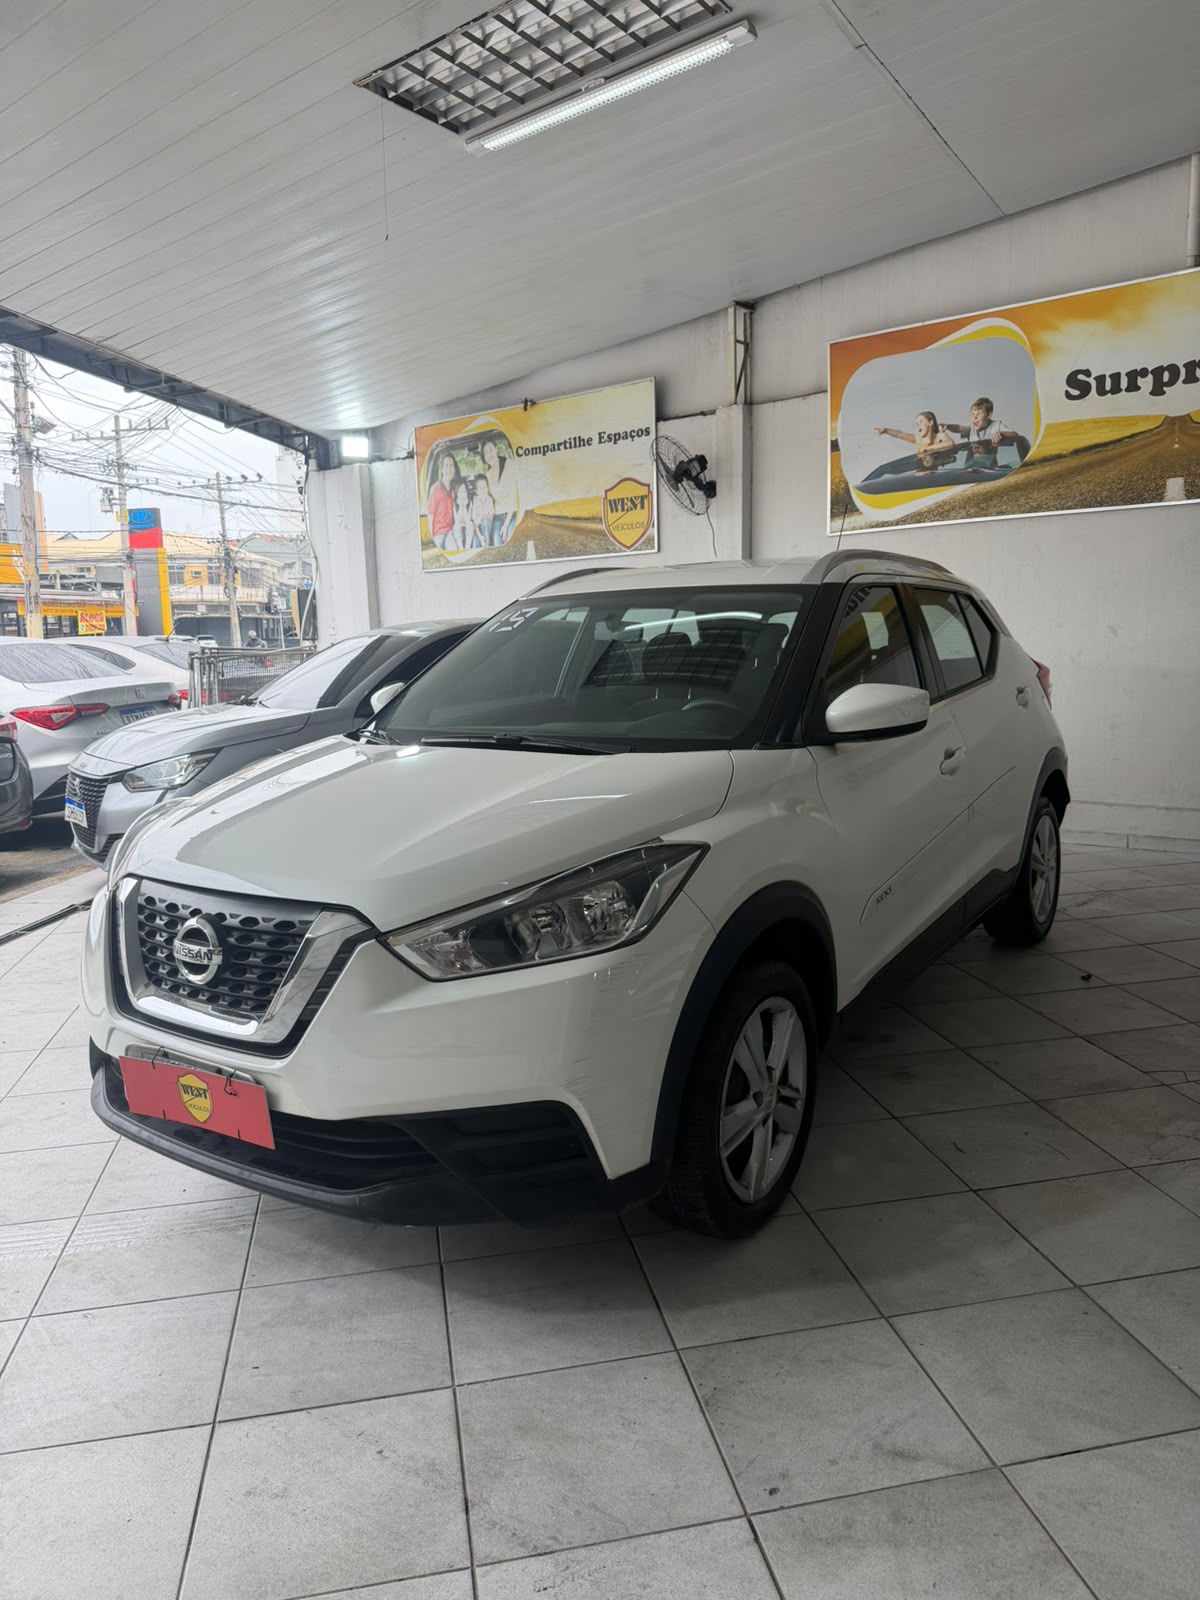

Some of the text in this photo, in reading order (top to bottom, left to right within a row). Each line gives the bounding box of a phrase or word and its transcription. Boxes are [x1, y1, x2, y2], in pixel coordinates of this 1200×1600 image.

[1065, 359, 1200, 401] Surpr
[515, 427, 651, 458] Compartilhe Espaços
[608, 495, 648, 513] WEST
[612, 521, 645, 532] VEÍCULOS
[174, 944, 213, 961] NISSAN
[180, 1084, 208, 1100] WEST
